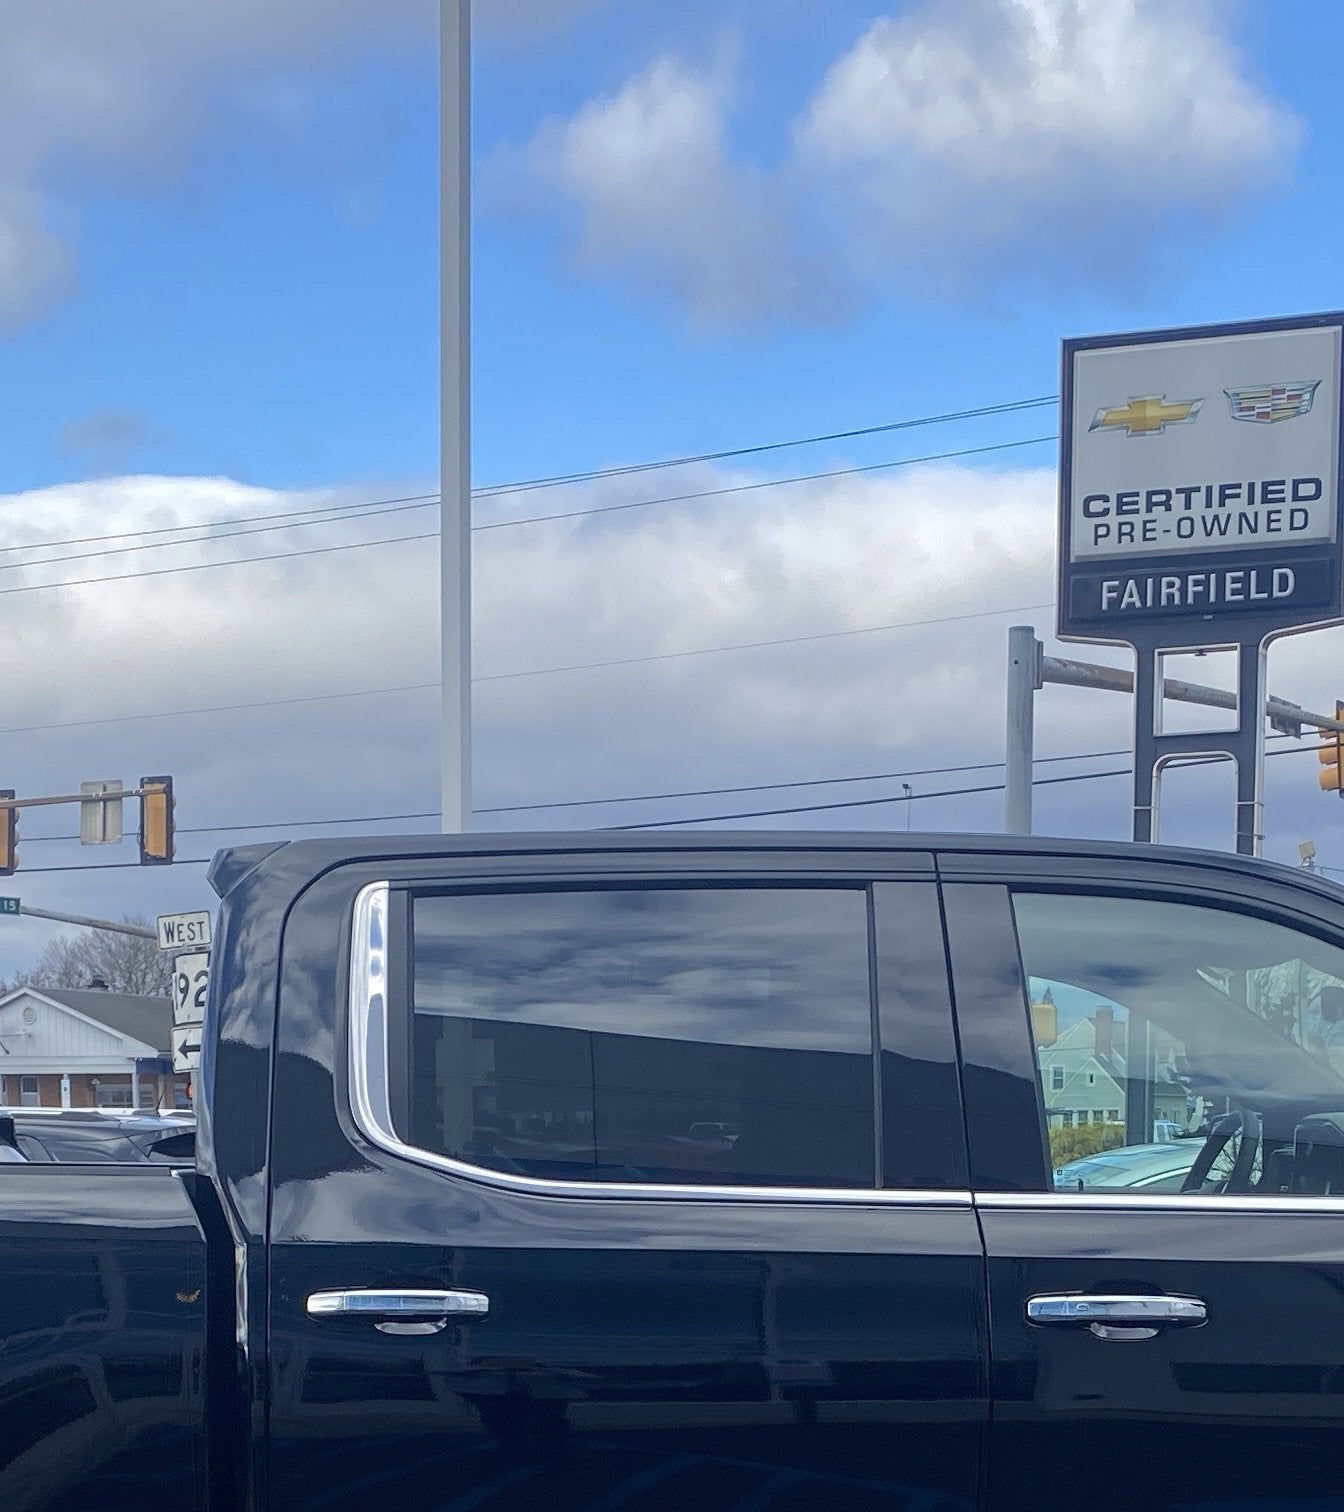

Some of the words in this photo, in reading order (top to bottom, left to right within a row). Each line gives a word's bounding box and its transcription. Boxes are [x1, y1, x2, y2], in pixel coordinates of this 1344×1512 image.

[1083, 477, 1322, 519] CERTIFIED
[1093, 508, 1309, 545] PRE-OWNED
[1101, 567, 1296, 611] FAIRFIELD
[3, 900, 17, 911] 15
[164, 921, 204, 944] WEST
